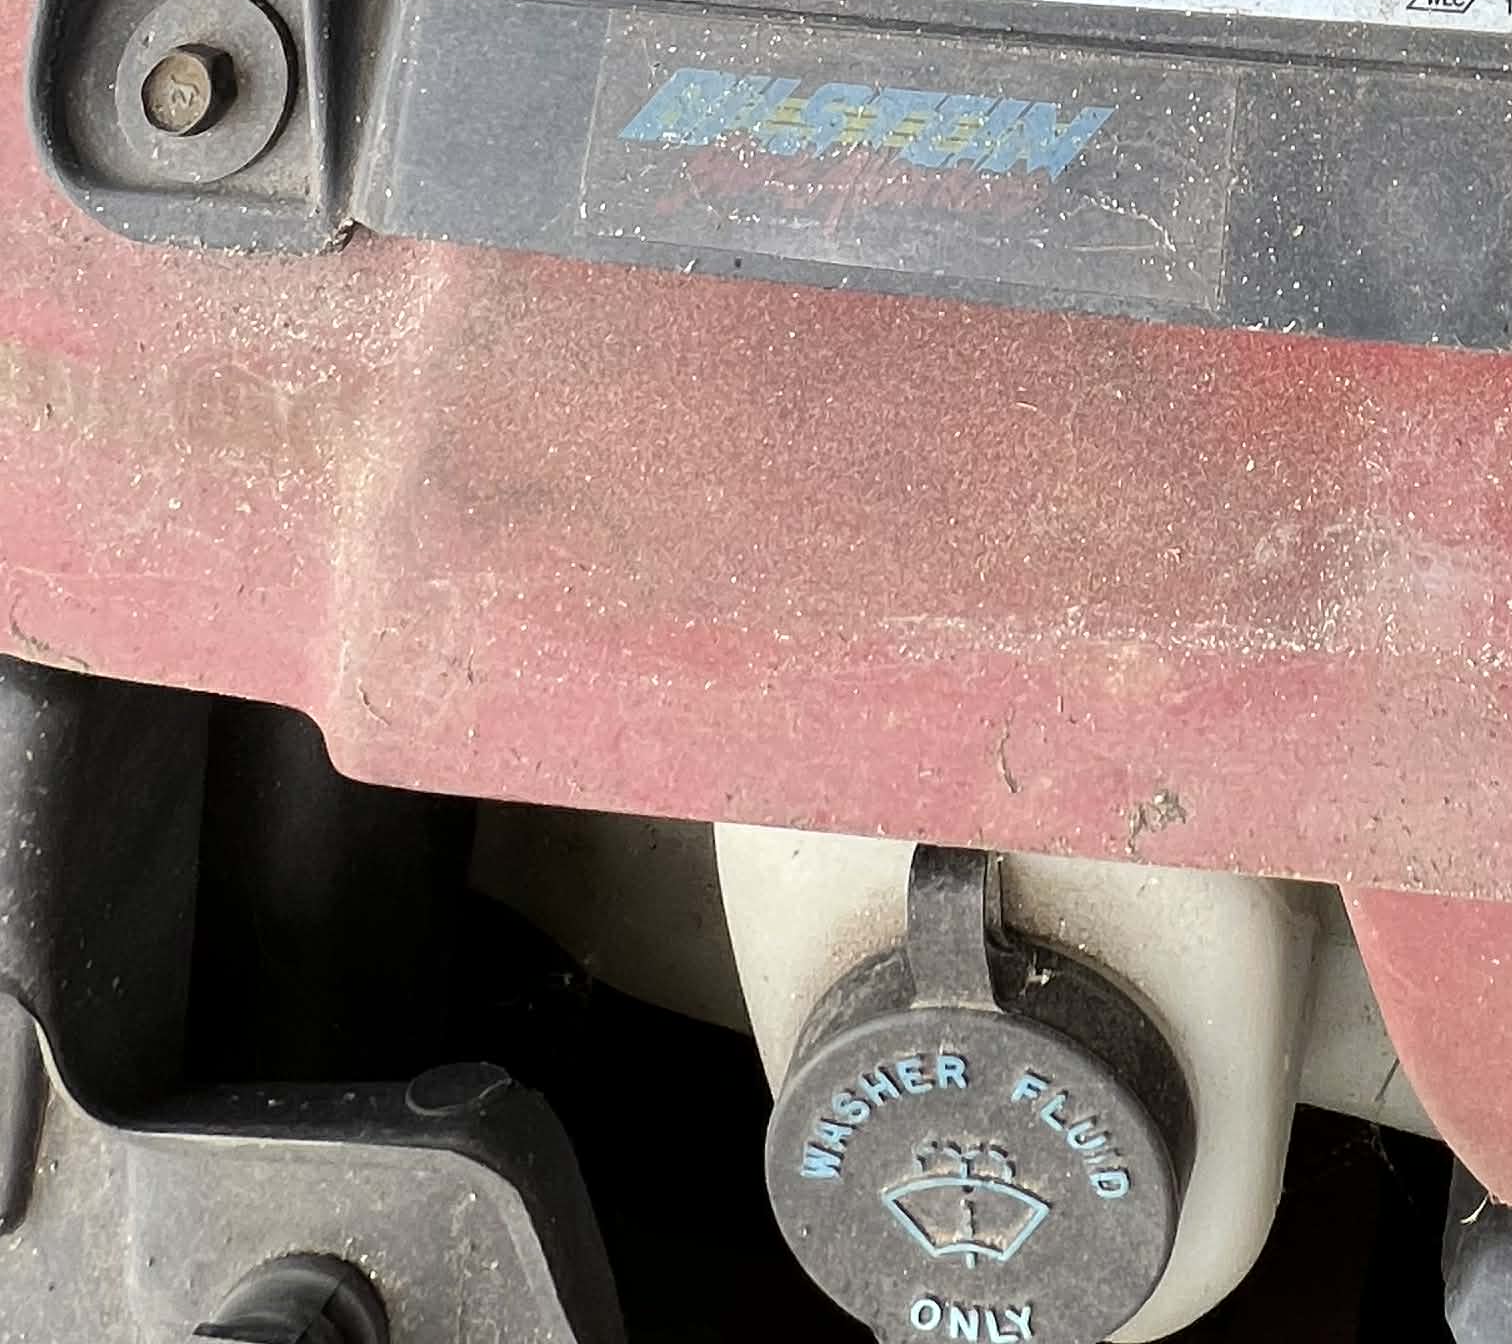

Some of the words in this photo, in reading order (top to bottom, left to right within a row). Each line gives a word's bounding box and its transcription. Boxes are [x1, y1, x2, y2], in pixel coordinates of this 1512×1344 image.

[799, 1054, 969, 1183] WASHER
[1010, 1068, 1133, 1200] FLUID
[909, 1296, 1036, 1344] ONLY
